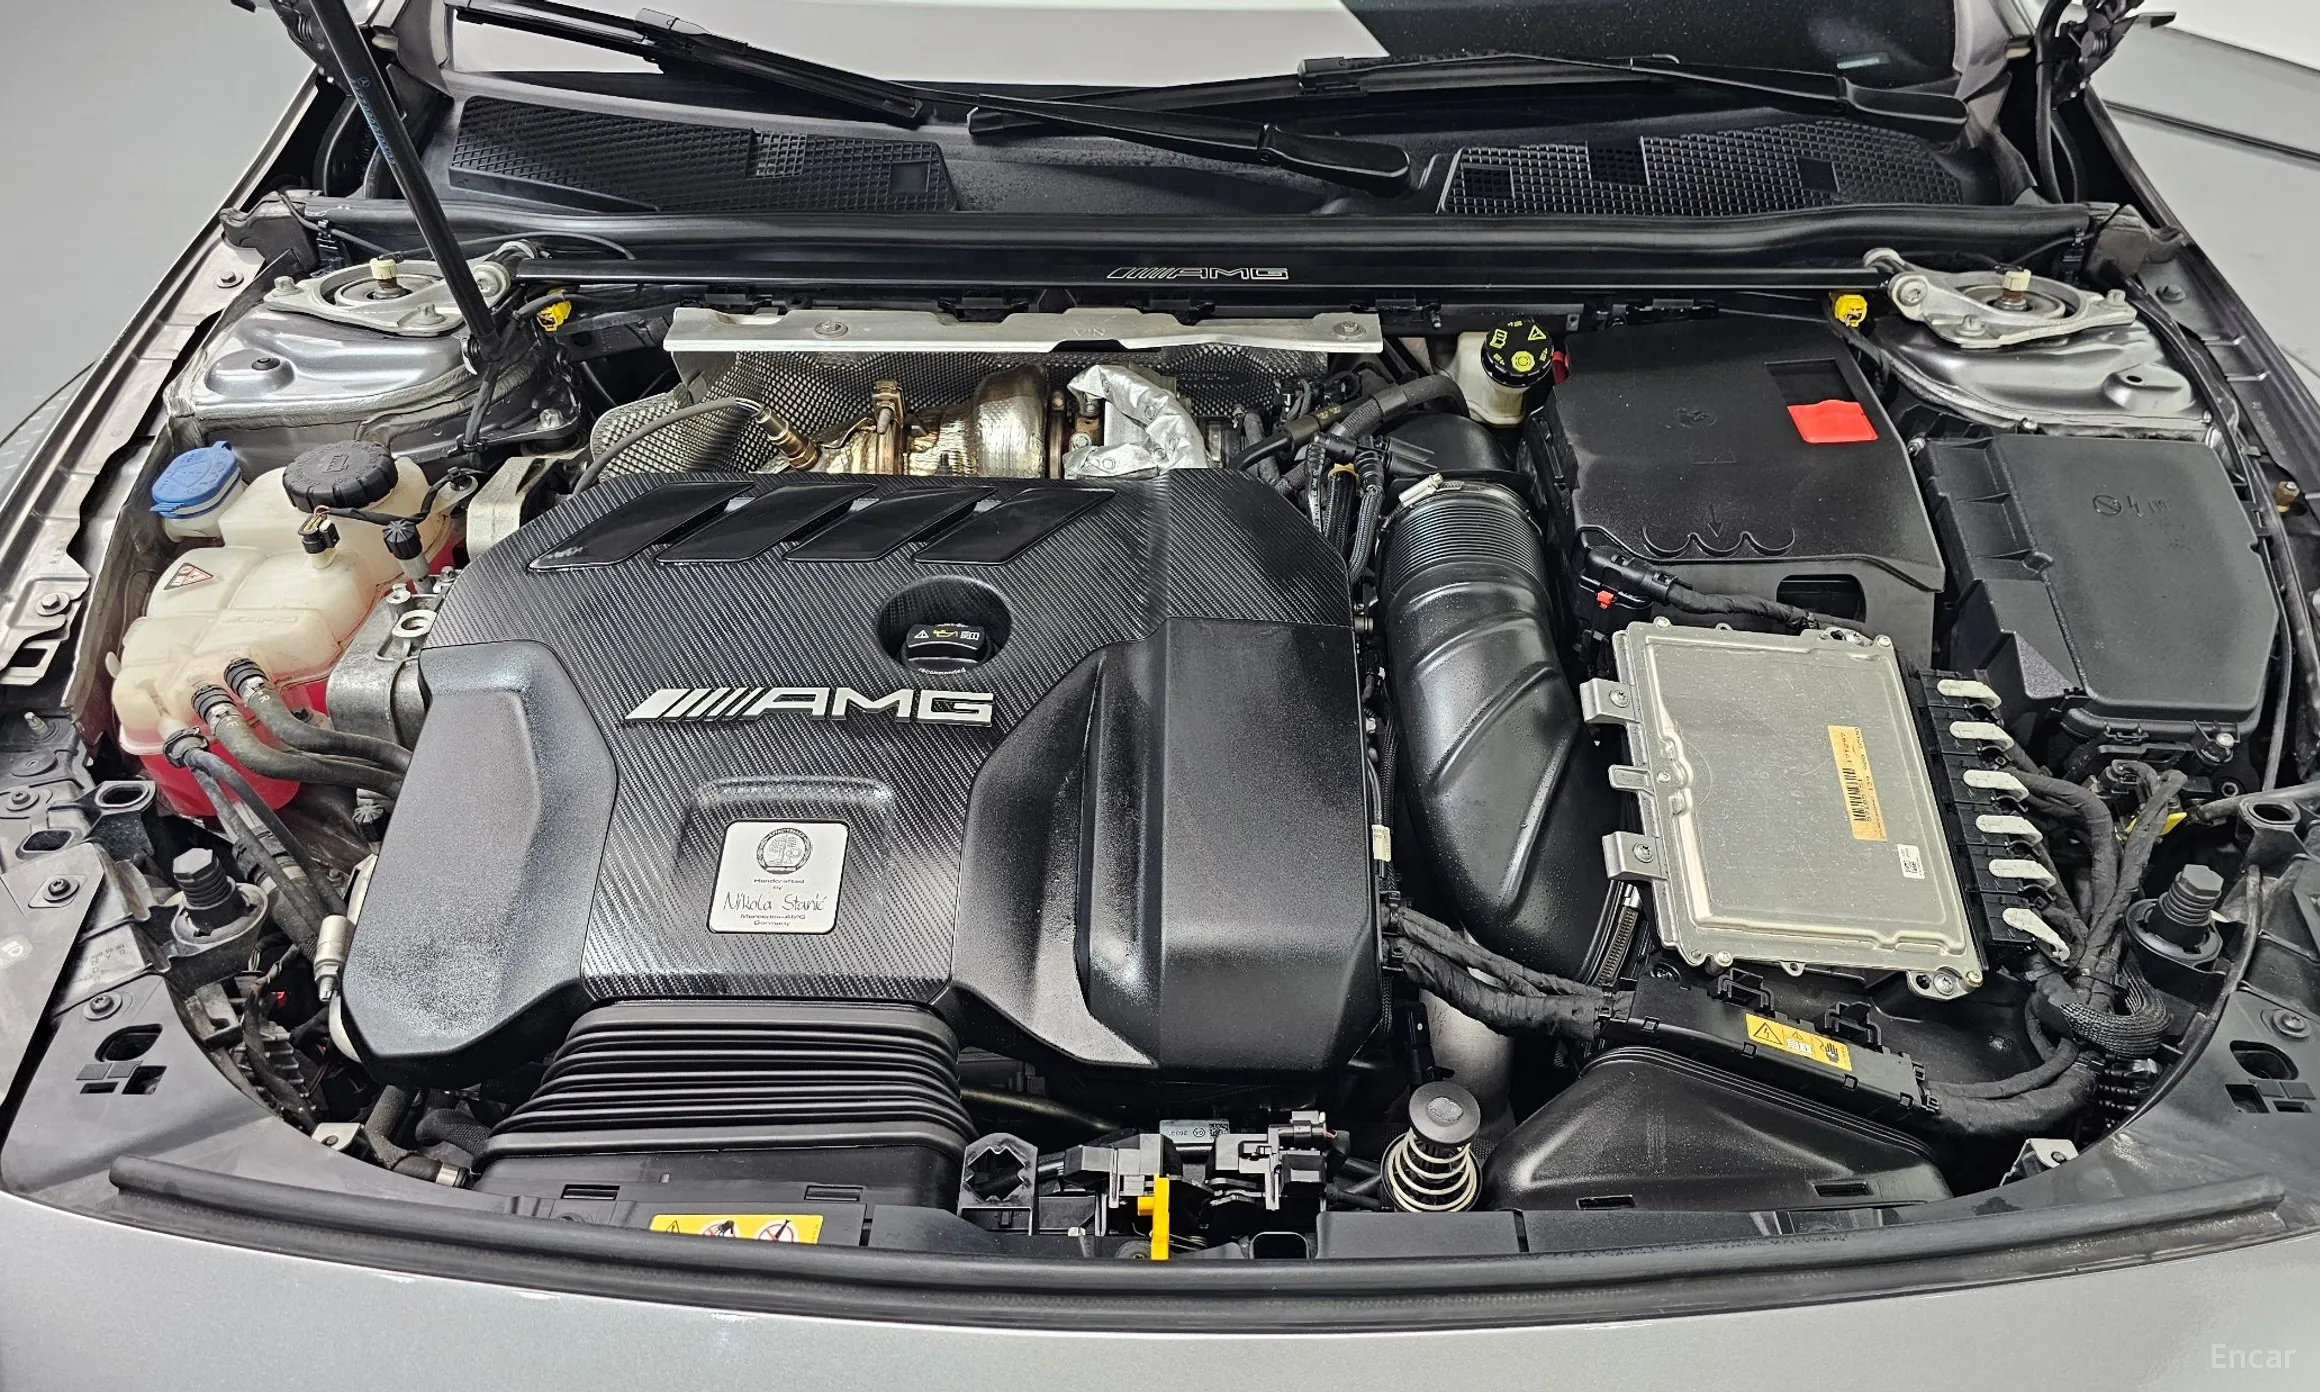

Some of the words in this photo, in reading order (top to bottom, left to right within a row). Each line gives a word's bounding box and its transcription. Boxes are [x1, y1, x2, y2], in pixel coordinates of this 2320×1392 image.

[1166, 267, 1289, 280] AMG
[740, 686, 994, 727] AMG
[722, 891, 772, 911] Nikola
